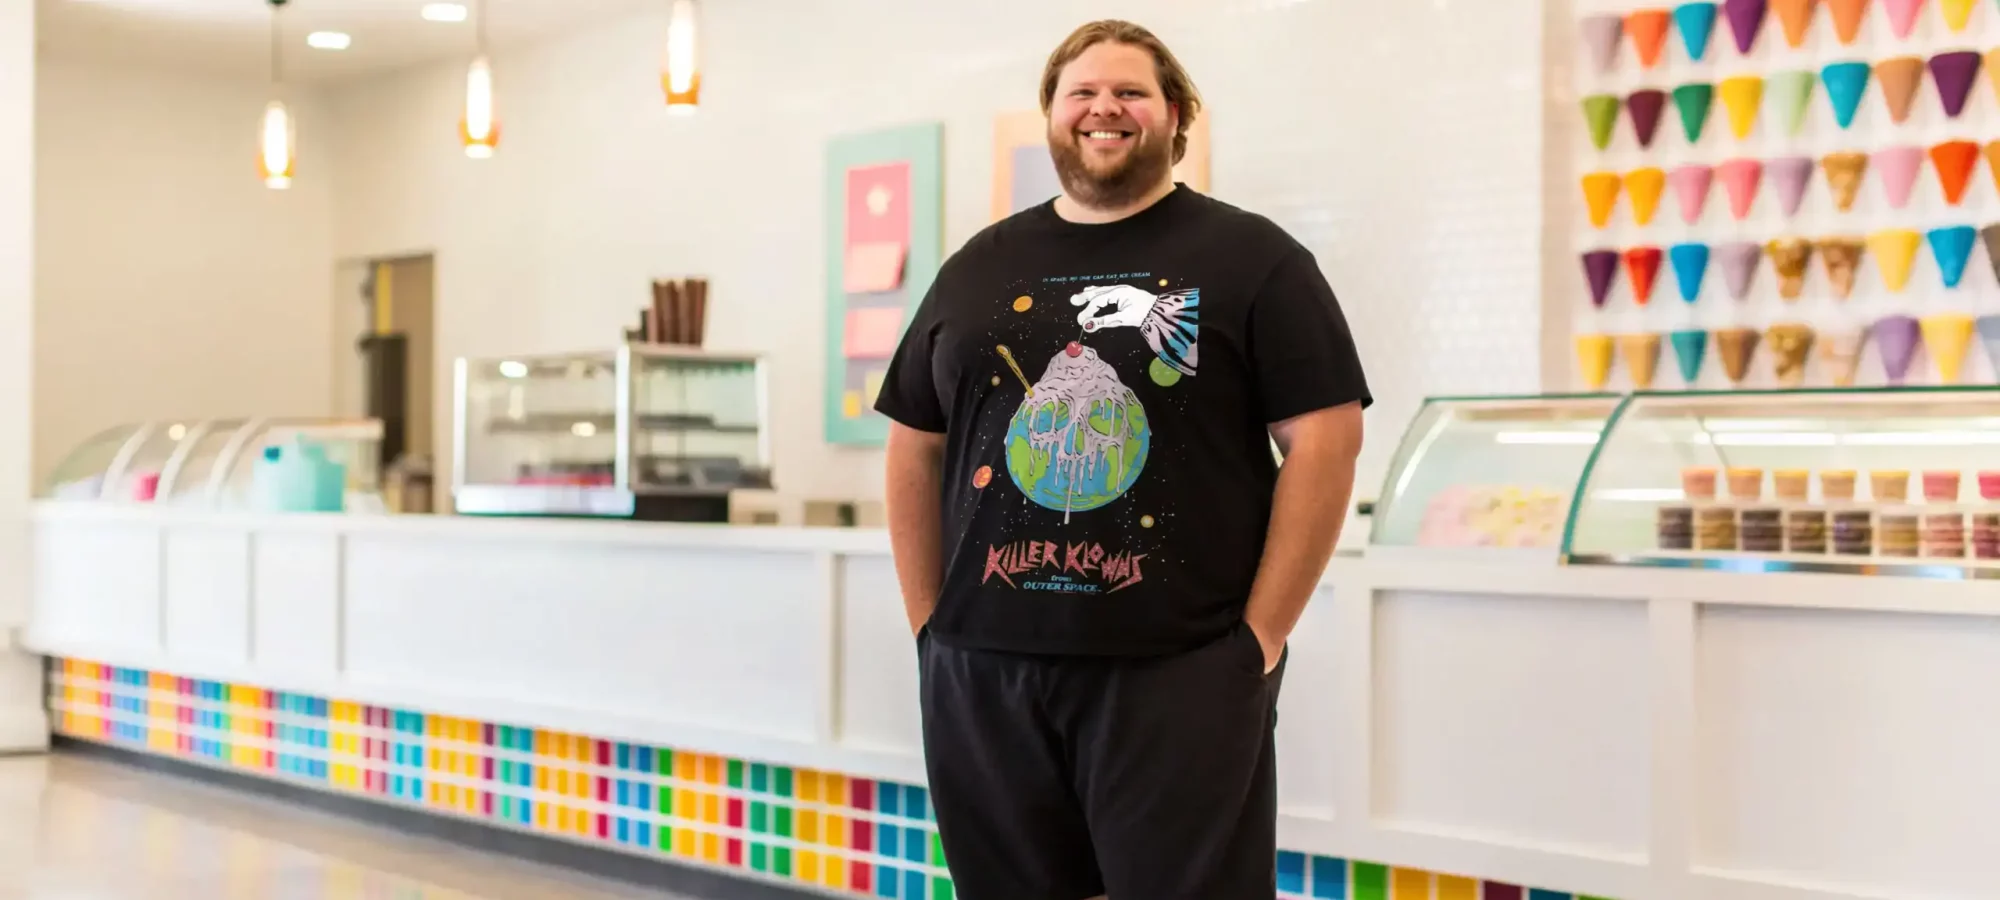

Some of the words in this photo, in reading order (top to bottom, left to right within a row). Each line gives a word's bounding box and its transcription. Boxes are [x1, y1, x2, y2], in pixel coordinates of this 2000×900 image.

[982, 540, 1061, 590] KILLER
[1063, 540, 1148, 594] KLOWNS
[1023, 581, 1062, 590] OUTER
[1063, 583, 1098, 592] SPACE
